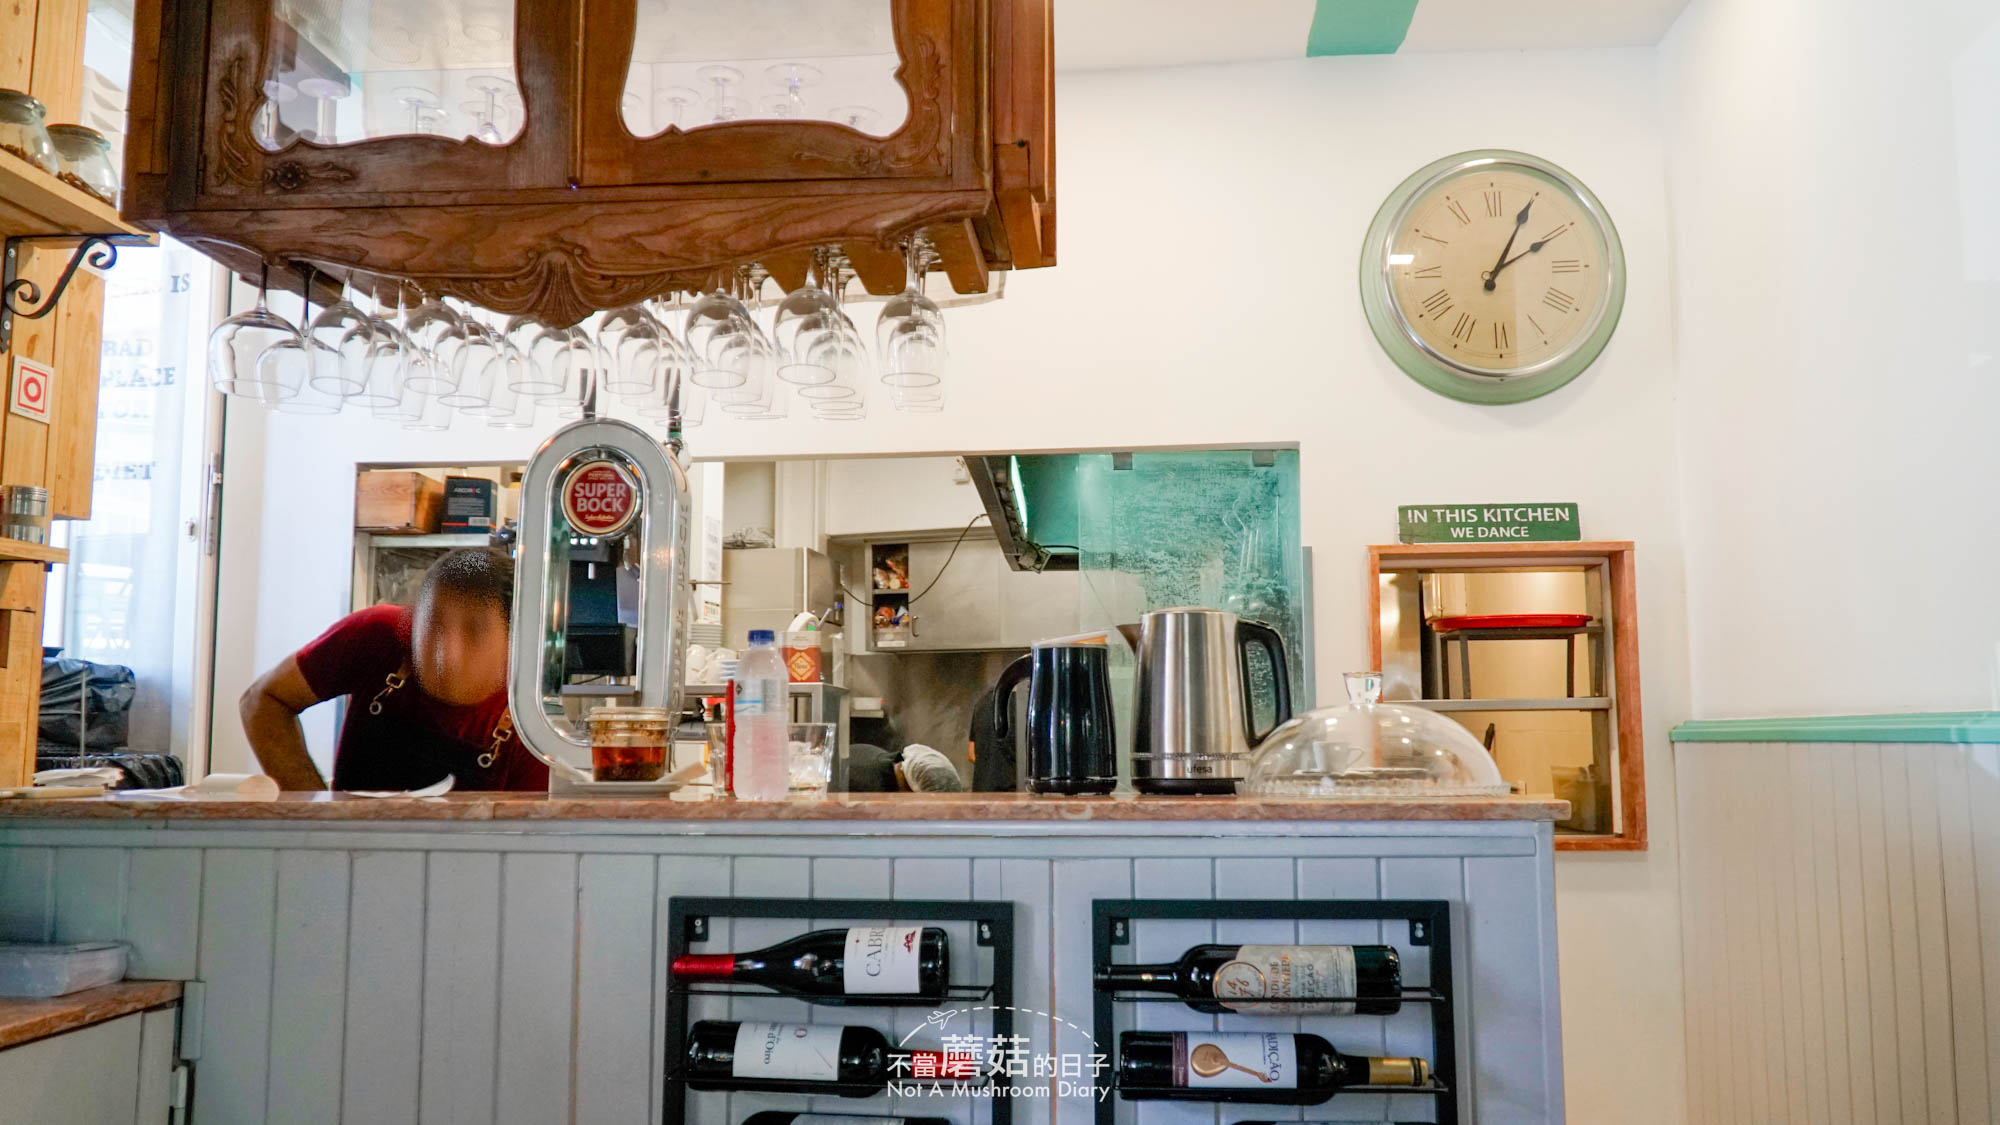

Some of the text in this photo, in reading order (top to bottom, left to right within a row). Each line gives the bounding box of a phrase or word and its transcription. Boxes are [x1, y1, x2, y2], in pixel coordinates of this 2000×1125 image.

[171, 273, 190, 293] IS
[574, 482, 627, 497] SUPER
[576, 498, 624, 512] BOCK
[1407, 507, 1570, 523] IN THIS KITCHEN
[1450, 526, 1530, 538] WE DANCE
[1187, 764, 1212, 773] ufesa
